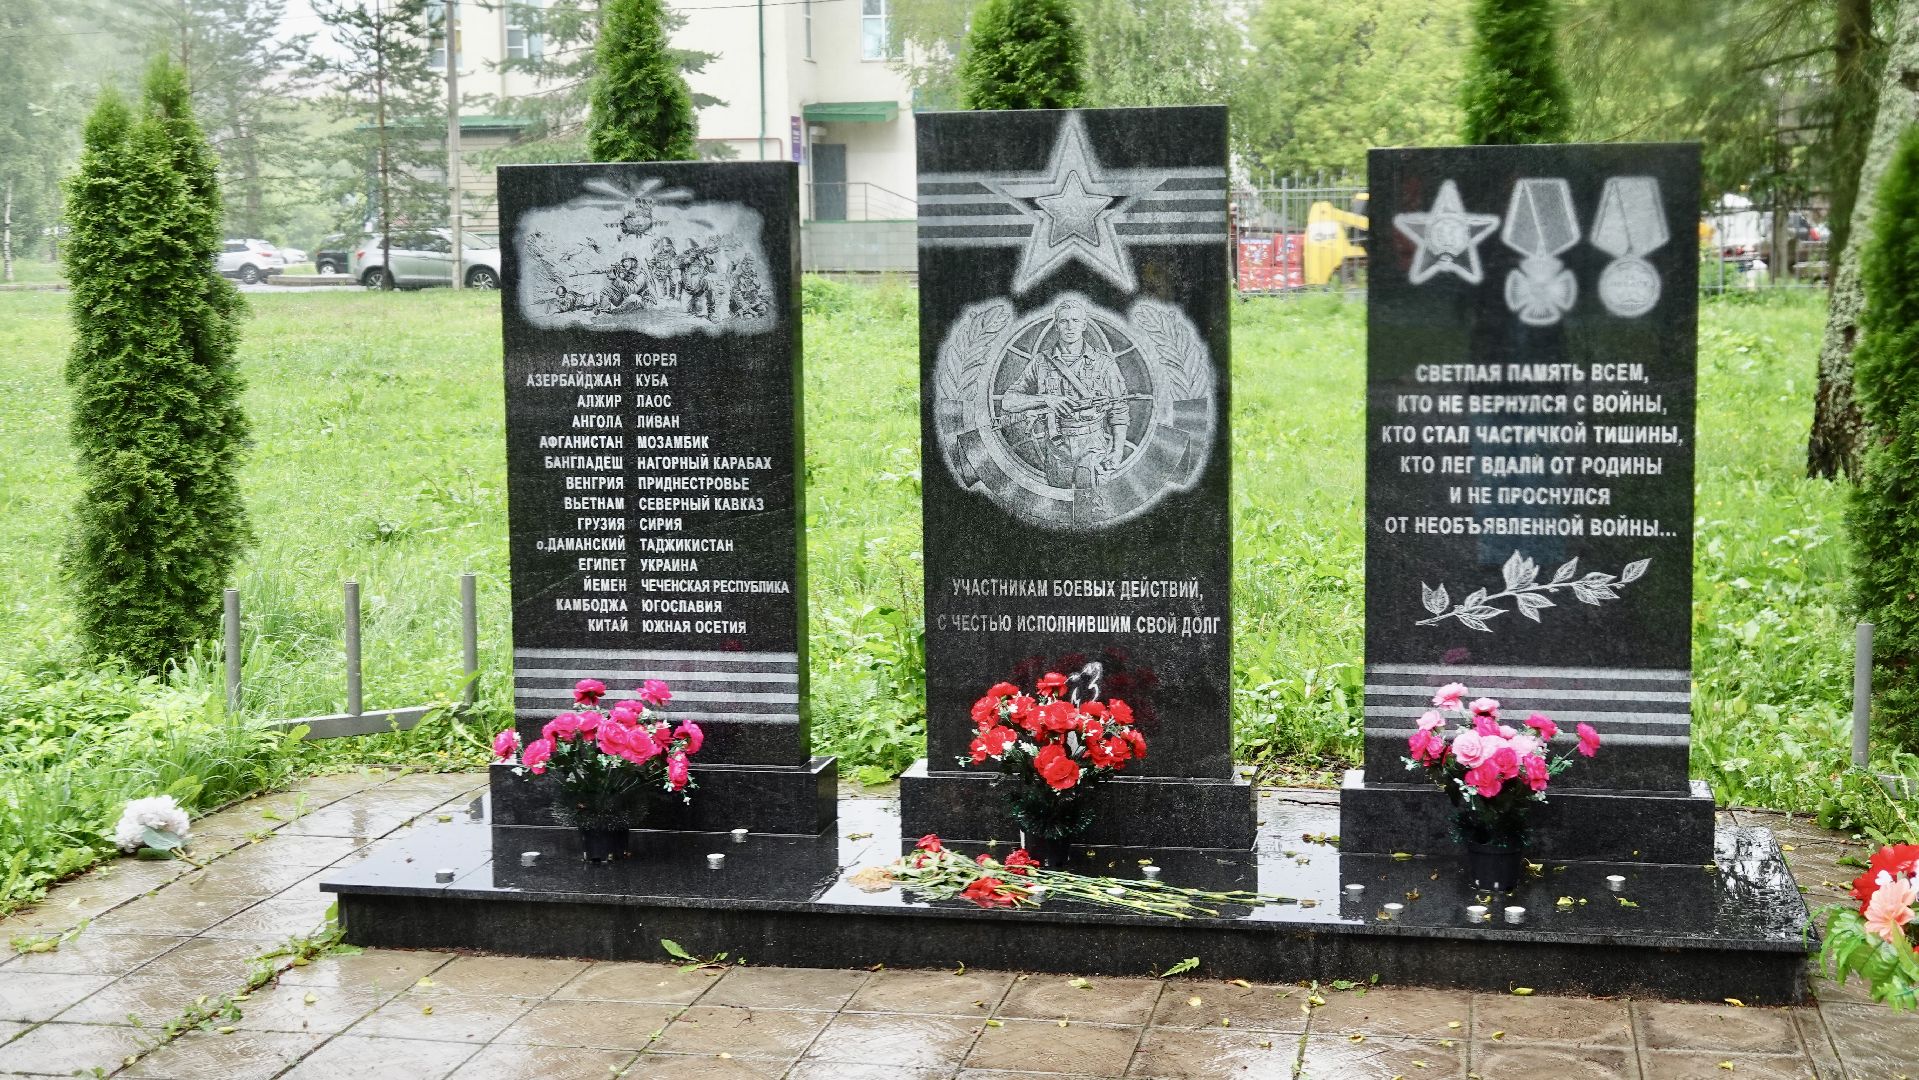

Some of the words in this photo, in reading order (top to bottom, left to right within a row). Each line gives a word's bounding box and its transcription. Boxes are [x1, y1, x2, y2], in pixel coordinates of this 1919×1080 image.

[562, 354, 621, 366] АБХАЗИЯ
[635, 354, 677, 366] КОРЕЯ
[526, 371, 621, 389] АЗЕРБАЙДЖАН
[636, 374, 668, 387] КУБА
[1416, 364, 1501, 382] СВЕТЛАЯ
[1507, 364, 1585, 382] ПАМЯТЬ
[1591, 363, 1649, 384] ВСЕМ,
[577, 395, 622, 407] АЛЖИР
[636, 395, 671, 408] ЛАОС
[1398, 395, 1433, 413] КТО
[1439, 395, 1463, 412] НЕ
[1469, 395, 1567, 413] ВЕРНУЛСЯ
[1573, 394, 1585, 413] С
[1593, 390, 1668, 415] ВОЙНЫ,
[572, 415, 623, 428] АНГОЛА
[637, 415, 680, 428] ЛИВАН
[1382, 426, 1416, 443] КТО
[1422, 426, 1470, 443] СТАЛ
[1476, 422, 1587, 443] ЧАСТИЧКОЙ
[1593, 426, 1683, 446] ТИШИНЫ,
[539, 436, 623, 449] АФГАНИСТАН
[637, 436, 709, 449] МОЗАМБИК
[545, 456, 623, 472] БАНГЛАДЕШ
[637, 454, 709, 470] НАГОРНЫЙ
[713, 457, 772, 470] КАРАБАХ
[1400, 456, 1435, 473] КТО
[1440, 456, 1475, 473] ЛЕГ
[1482, 456, 1544, 477] ВДАЛИ
[1551, 456, 1574, 474] ОТ
[1582, 457, 1663, 478] РОДИНЫ
[566, 477, 624, 489] ВЕНГРИЯ
[638, 477, 749, 492] ПРИДНЕСТРОВЬЕ
[639, 495, 710, 511] СЕВЕРНЫЙ
[715, 498, 764, 511] КАВКАЗ
[1450, 487, 1461, 504] И
[1468, 487, 1492, 504] НЕ
[1498, 487, 1611, 505] ПРОСНУЛСЯ
[564, 497, 624, 510] ВЬЕТНАМ
[577, 518, 625, 530] ГРУЗИЯ
[640, 518, 682, 531] СИРИЯ
[1385, 517, 1408, 534] ОТ
[1415, 514, 1584, 536] НЕОБЪЯВЛЕННОЙ
[1590, 515, 1677, 537] ВОЙНЫ...
[537, 536, 625, 552] о.ДАМАНСКИЙ
[640, 539, 733, 553] ТАДЖИКИСТАН
[579, 558, 627, 570] ЕГИПЕТ
[640, 559, 698, 572] УКРАИНА
[584, 576, 627, 591] ЙЕМЕН
[641, 579, 710, 592] ЧЕЧЕНСКАЯ
[713, 580, 790, 594] РЕСПУБЛИКА
[953, 579, 1048, 596] УЧАСТНИКАМ
[1053, 580, 1116, 597] БОЕВЫХ
[1120, 576, 1204, 601] ДЕЙСТВИЙ,
[556, 599, 628, 613] КАМБОДЖА
[642, 600, 722, 613] ЮГОСЛАВИЯ
[588, 617, 628, 632] КИТАЙ
[642, 620, 691, 633] ЮЖНАЯ
[695, 621, 747, 633] ОСЕТИЯ
[937, 615, 947, 631] С
[952, 615, 1012, 632] ЧЕСТЬЮ
[1017, 615, 1131, 633] ИСПОЛНИВШИМ
[1137, 613, 1177, 634] СВОЙ
[1182, 616, 1221, 637] ДОЛГ
